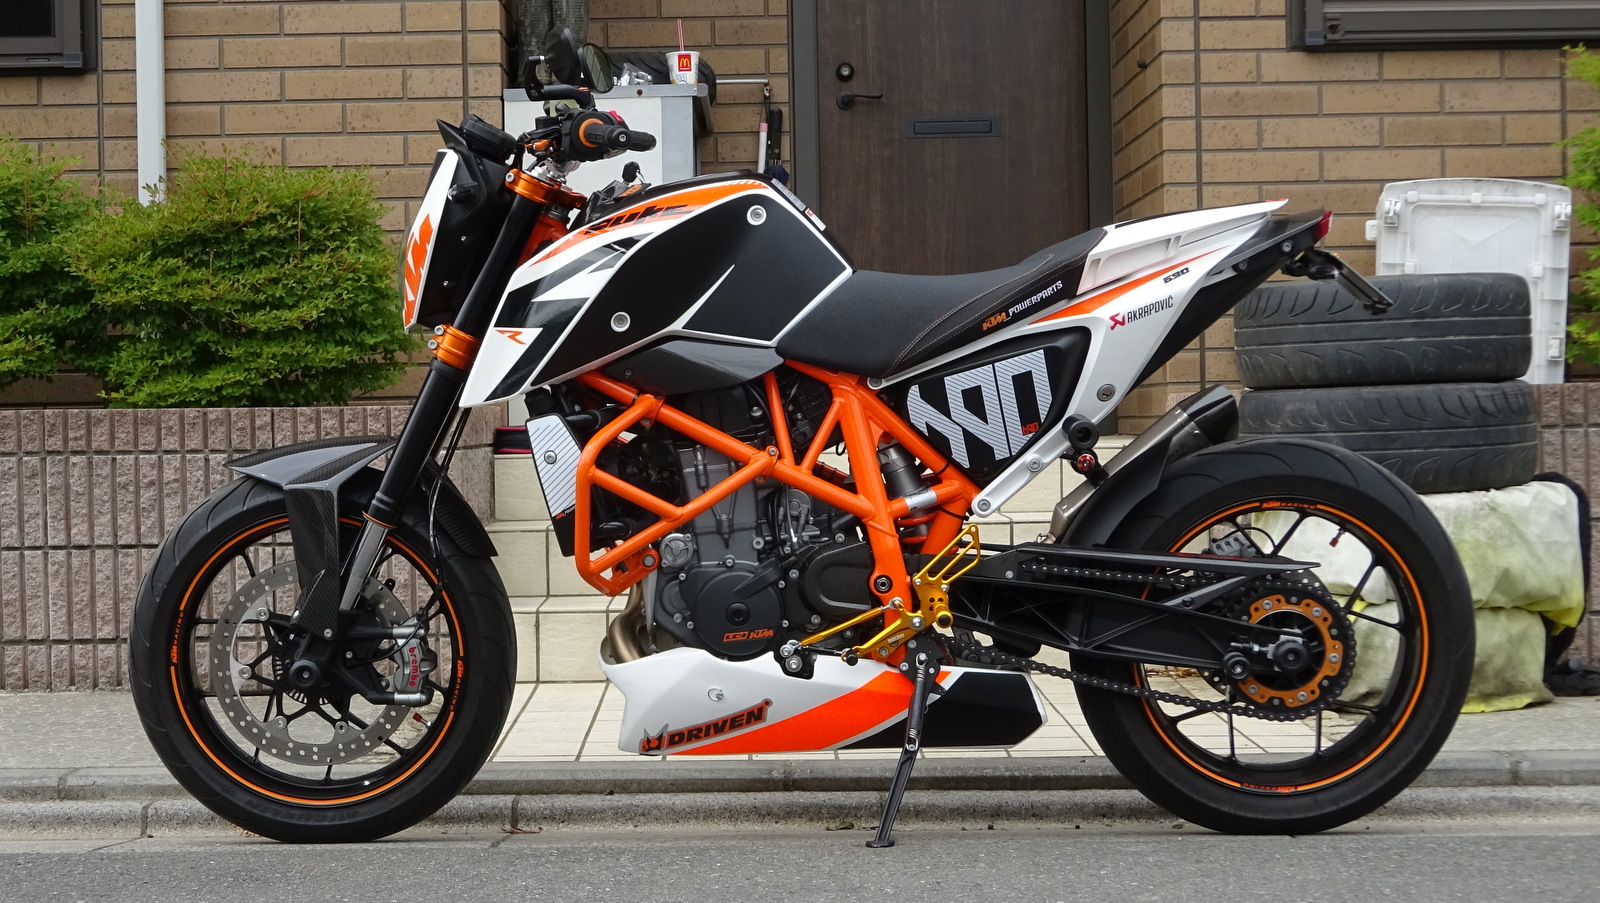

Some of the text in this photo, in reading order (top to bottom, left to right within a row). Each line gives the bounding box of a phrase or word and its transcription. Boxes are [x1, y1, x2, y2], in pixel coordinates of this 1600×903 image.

[1162, 266, 1190, 284] 690
[982, 311, 1007, 331] KTM
[749, 628, 774, 639] KTM
[408, 646, 420, 687] brembo
[667, 705, 765, 747] DRIVEN
